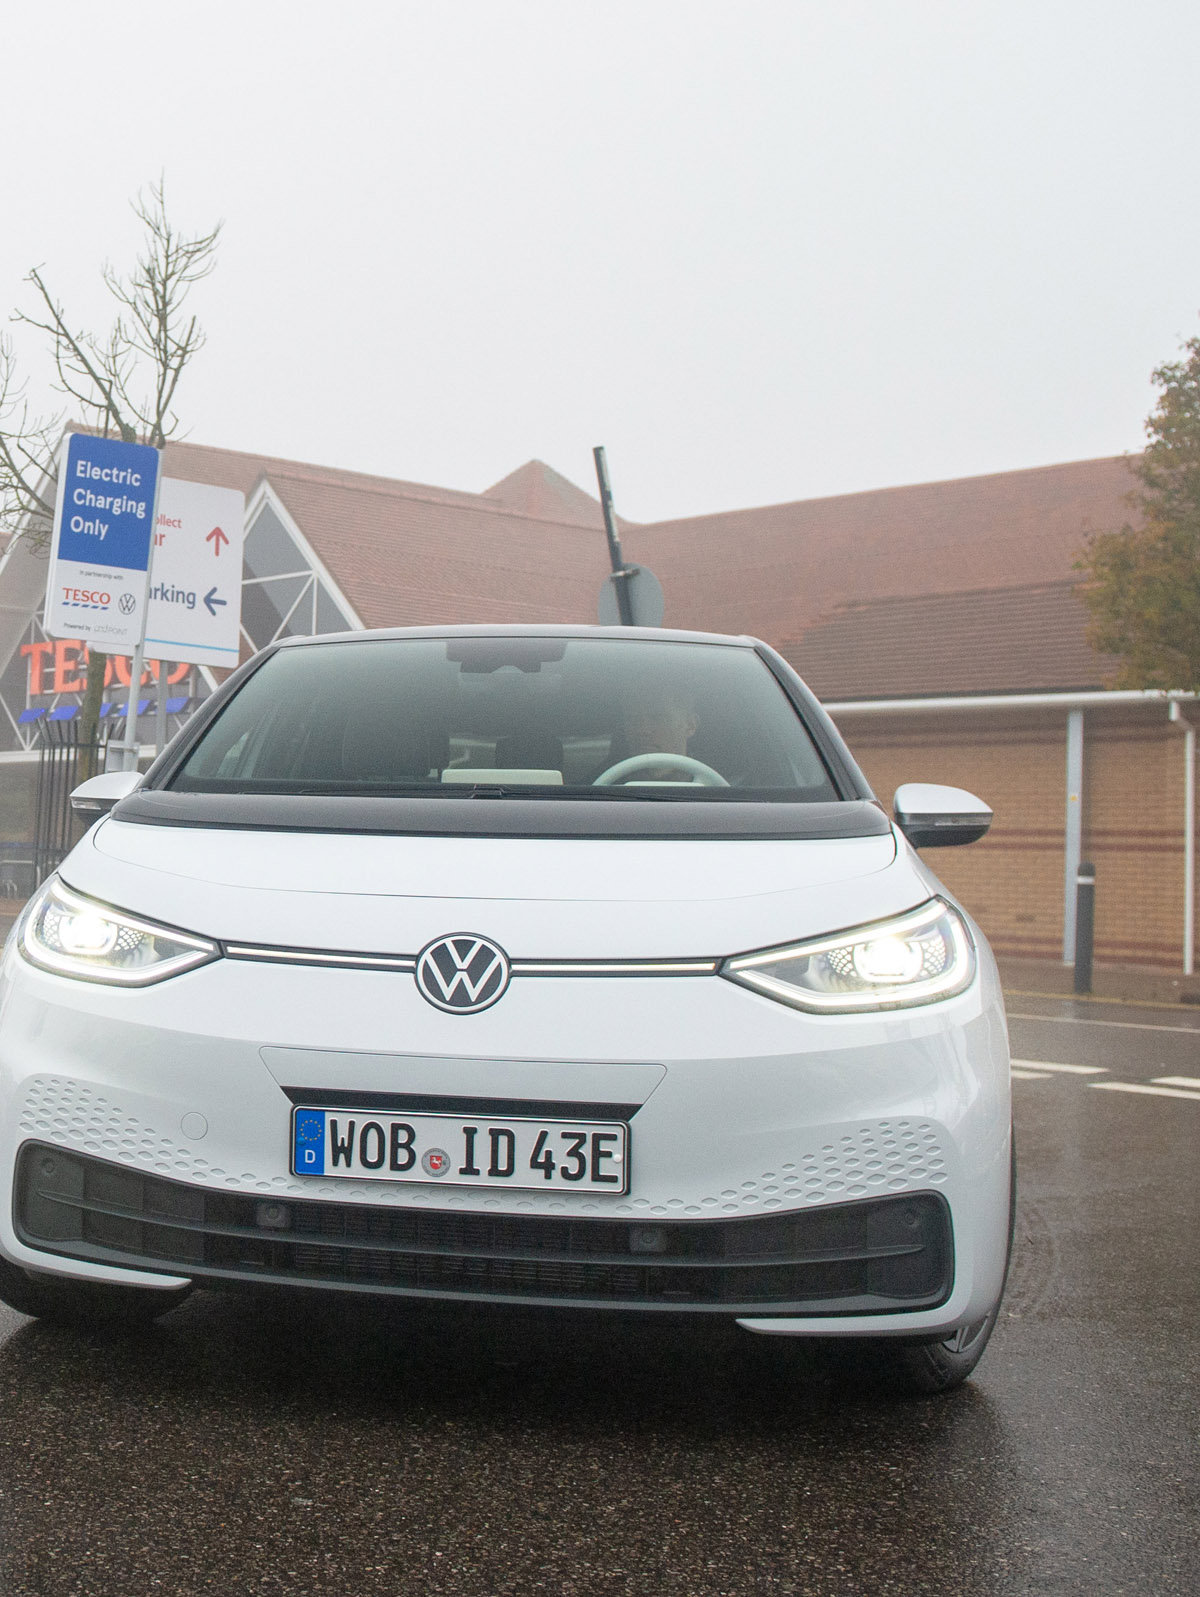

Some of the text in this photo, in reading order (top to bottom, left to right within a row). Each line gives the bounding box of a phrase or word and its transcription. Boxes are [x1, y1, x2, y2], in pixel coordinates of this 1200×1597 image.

[76, 460, 141, 487] Electric
[73, 488, 146, 519] Charging
[70, 515, 109, 541] Only
[62, 587, 111, 605] TESCO
[304, 1149, 315, 1163] D
[329, 1118, 416, 1172] WOB
[459, 1125, 516, 1178] ID
[529, 1130, 619, 1183] 43E
